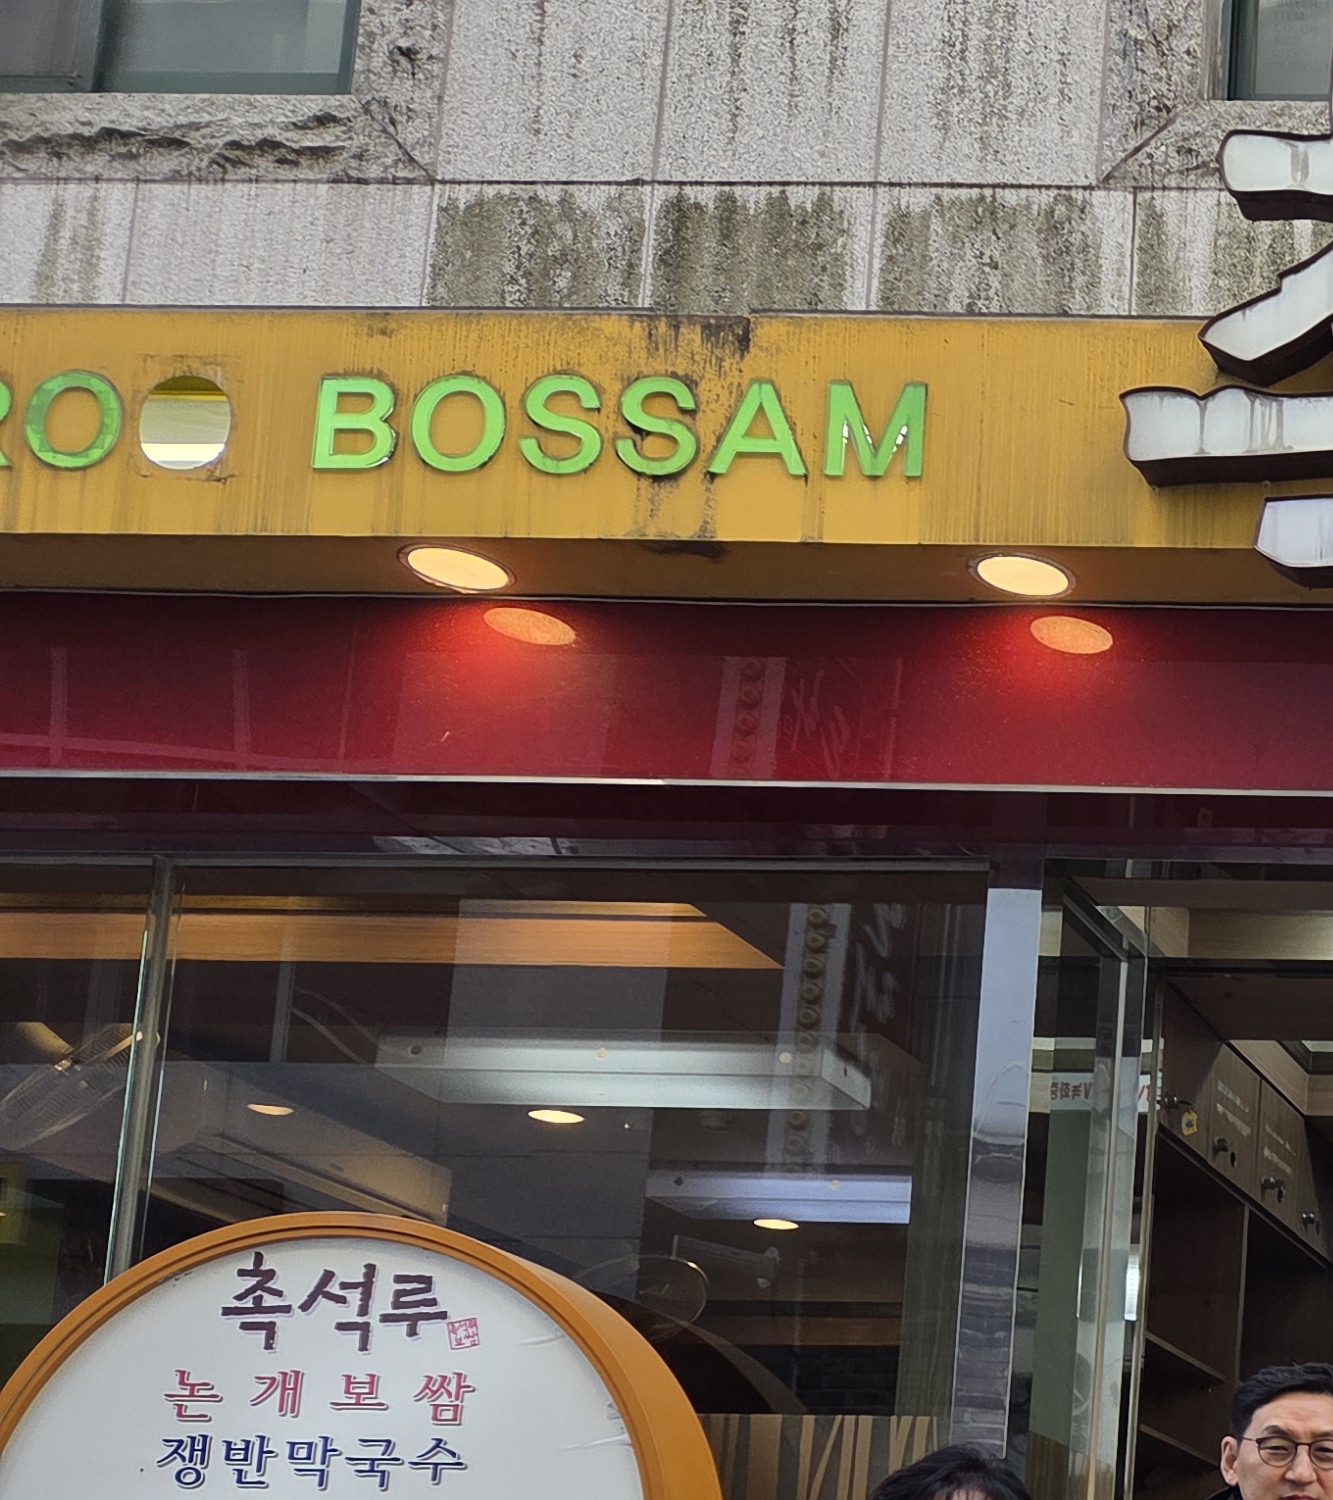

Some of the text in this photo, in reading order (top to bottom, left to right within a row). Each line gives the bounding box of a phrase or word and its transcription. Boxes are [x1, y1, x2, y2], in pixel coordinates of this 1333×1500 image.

[0, 369, 929, 480] O BOSSAM
[221, 1251, 453, 1352] 촉석루
[156, 1433, 468, 1491] 쟁반막국수
